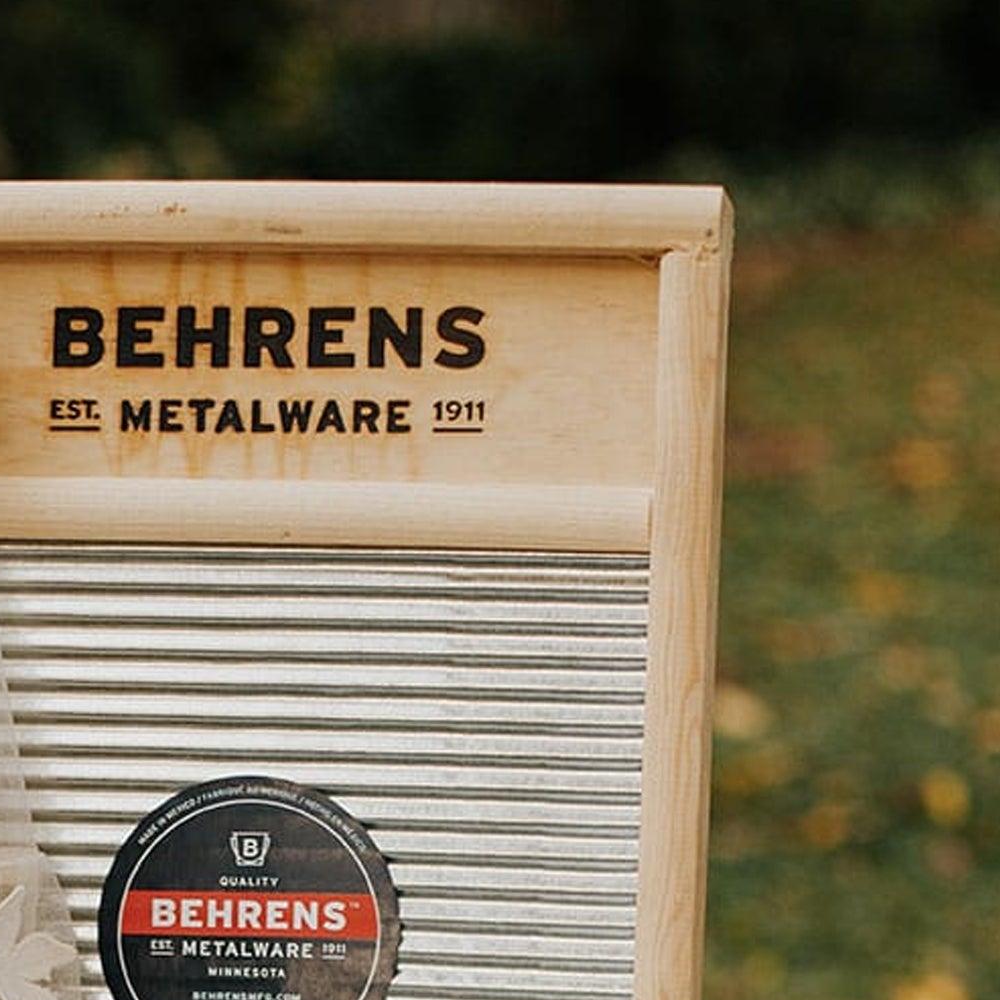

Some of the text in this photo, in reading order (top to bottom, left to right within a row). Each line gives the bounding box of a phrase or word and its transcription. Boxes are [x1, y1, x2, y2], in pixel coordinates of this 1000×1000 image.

[52, 305, 486, 369] BEHRENS
[50, 399, 486, 433] EST. METALWARE 1911
[242, 838, 259, 858] B
[219, 875, 280, 888] QUALITY
[151, 897, 348, 932] BEHRENS
[150, 939, 346, 959] EST. METALWARE 1911
[208, 966, 287, 979] MINNESOTA
